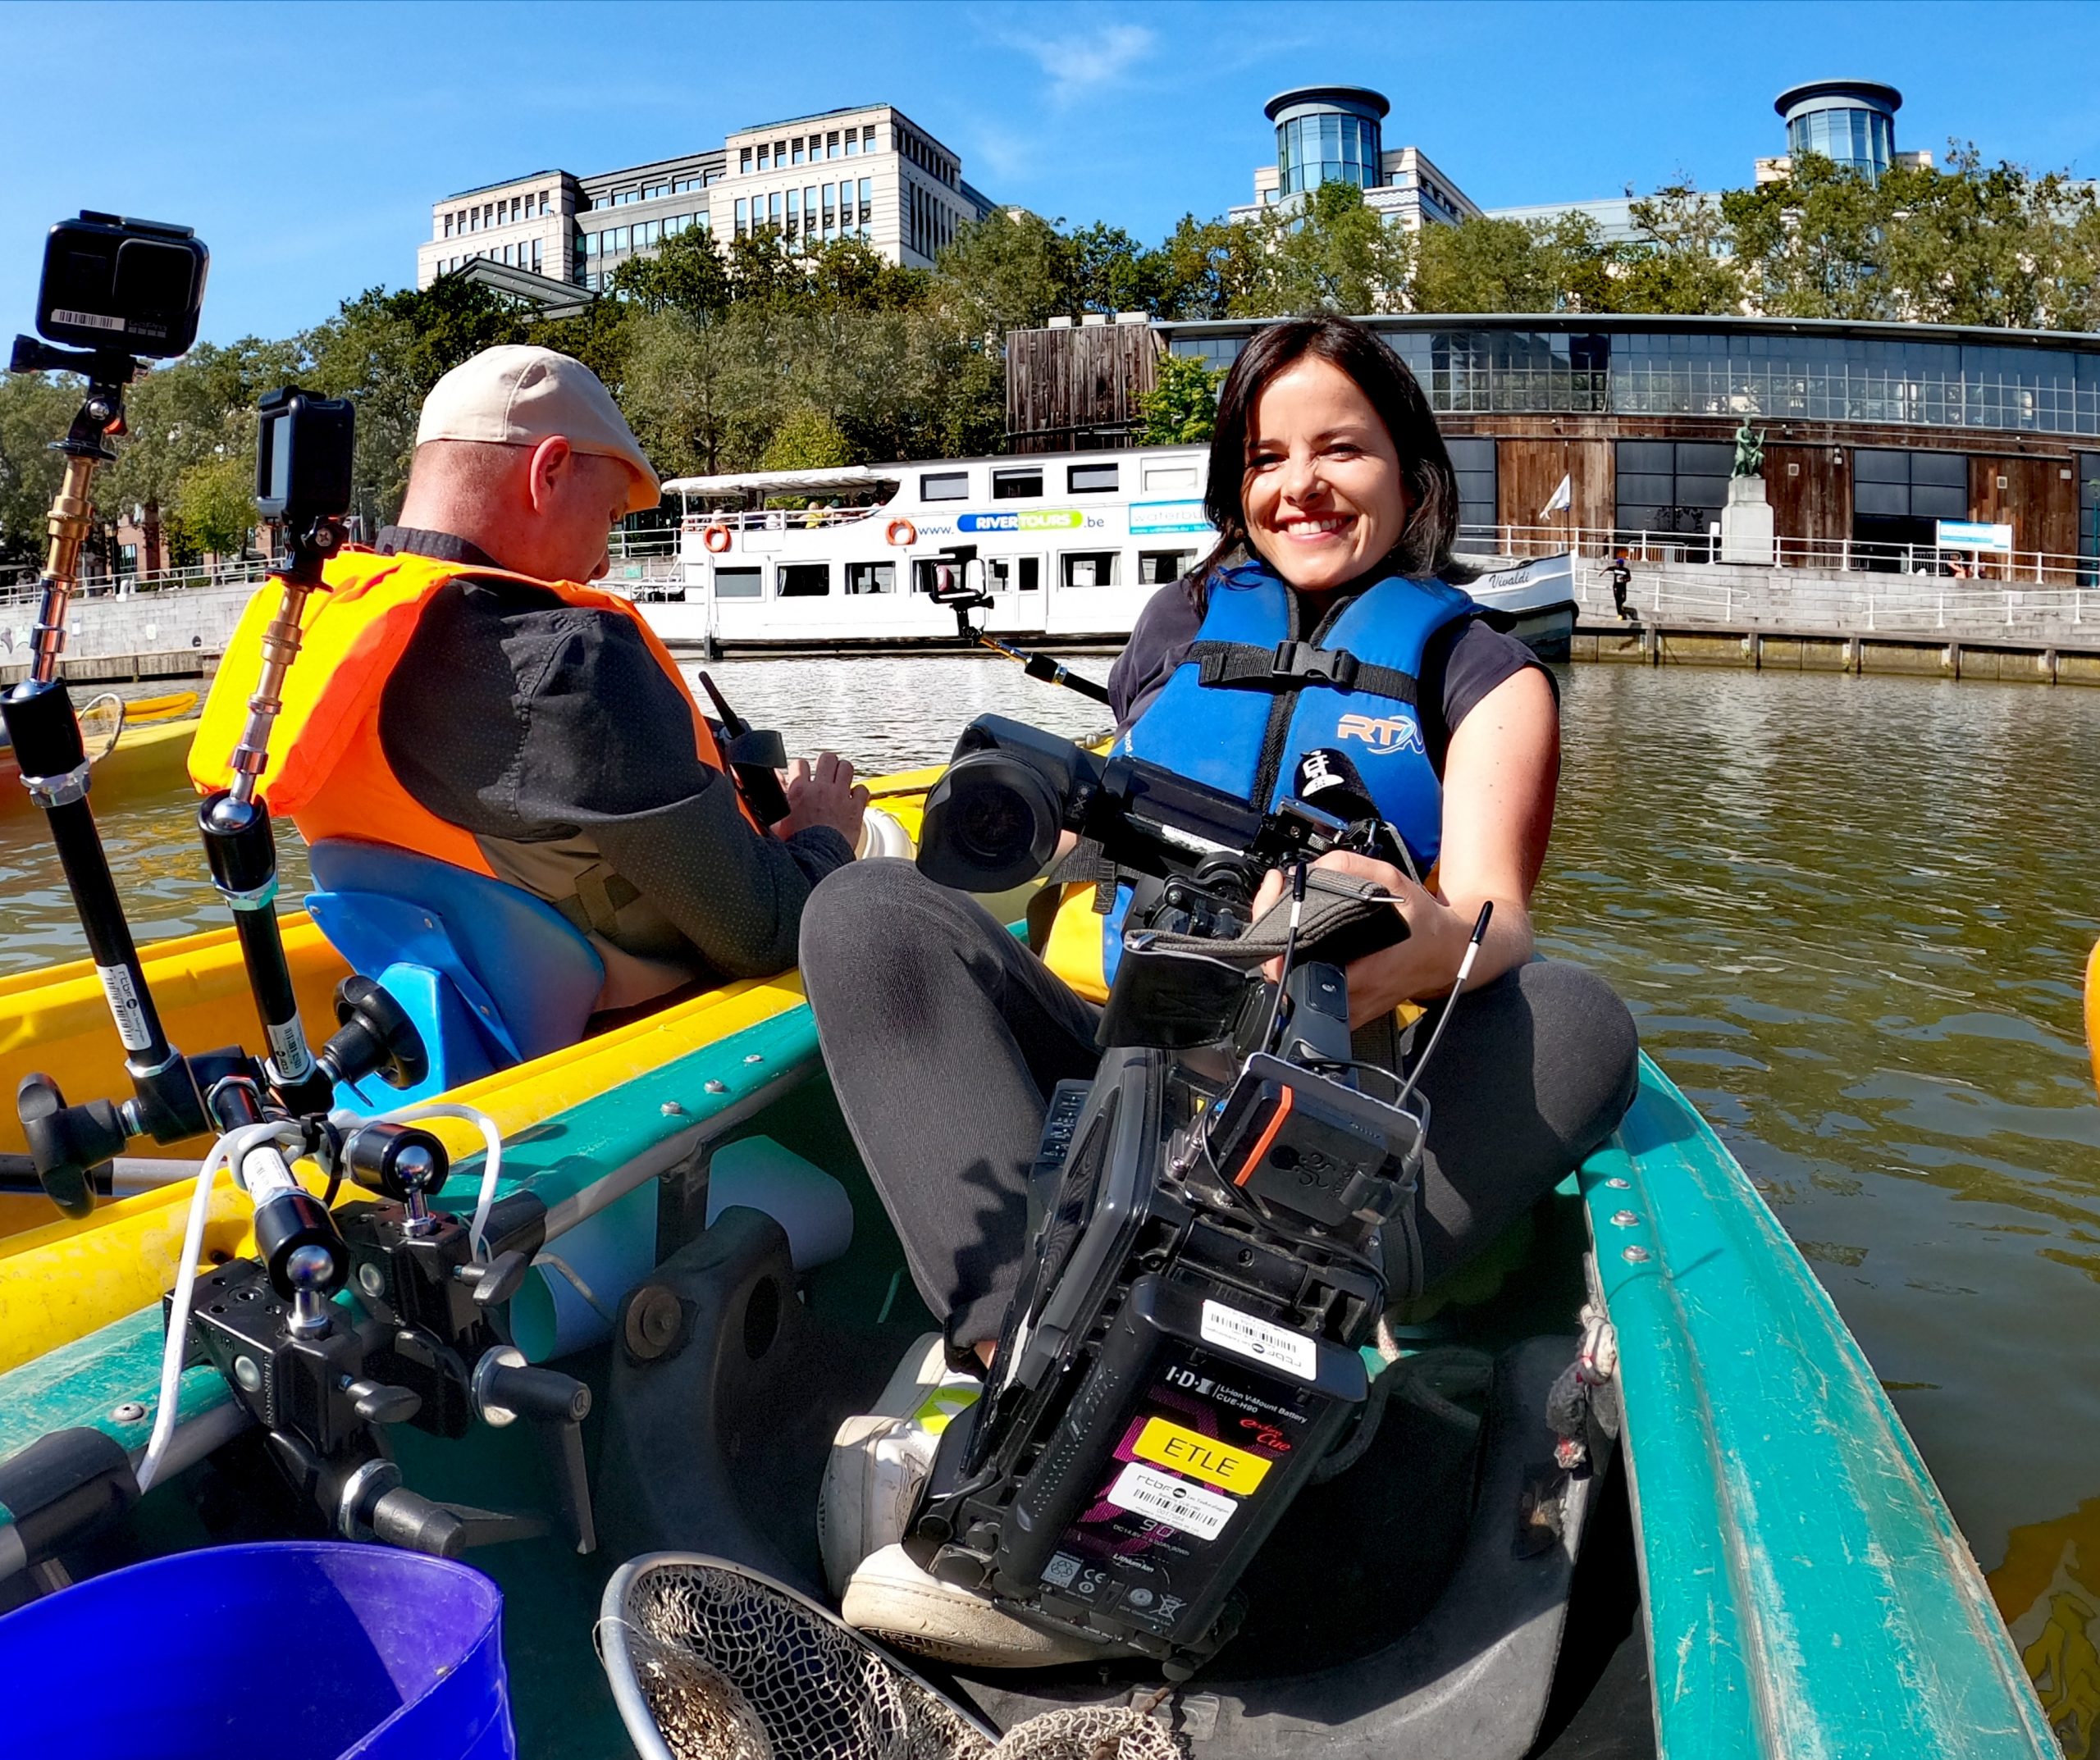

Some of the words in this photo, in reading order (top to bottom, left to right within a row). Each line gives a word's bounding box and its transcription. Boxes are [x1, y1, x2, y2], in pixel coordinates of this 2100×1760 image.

[1489, 571, 1530, 589] Vivaldi
[1278, 1407, 1308, 1425] Battery
[1164, 1437, 1239, 1477] ETLE
[1139, 1519, 1175, 1538] 90
